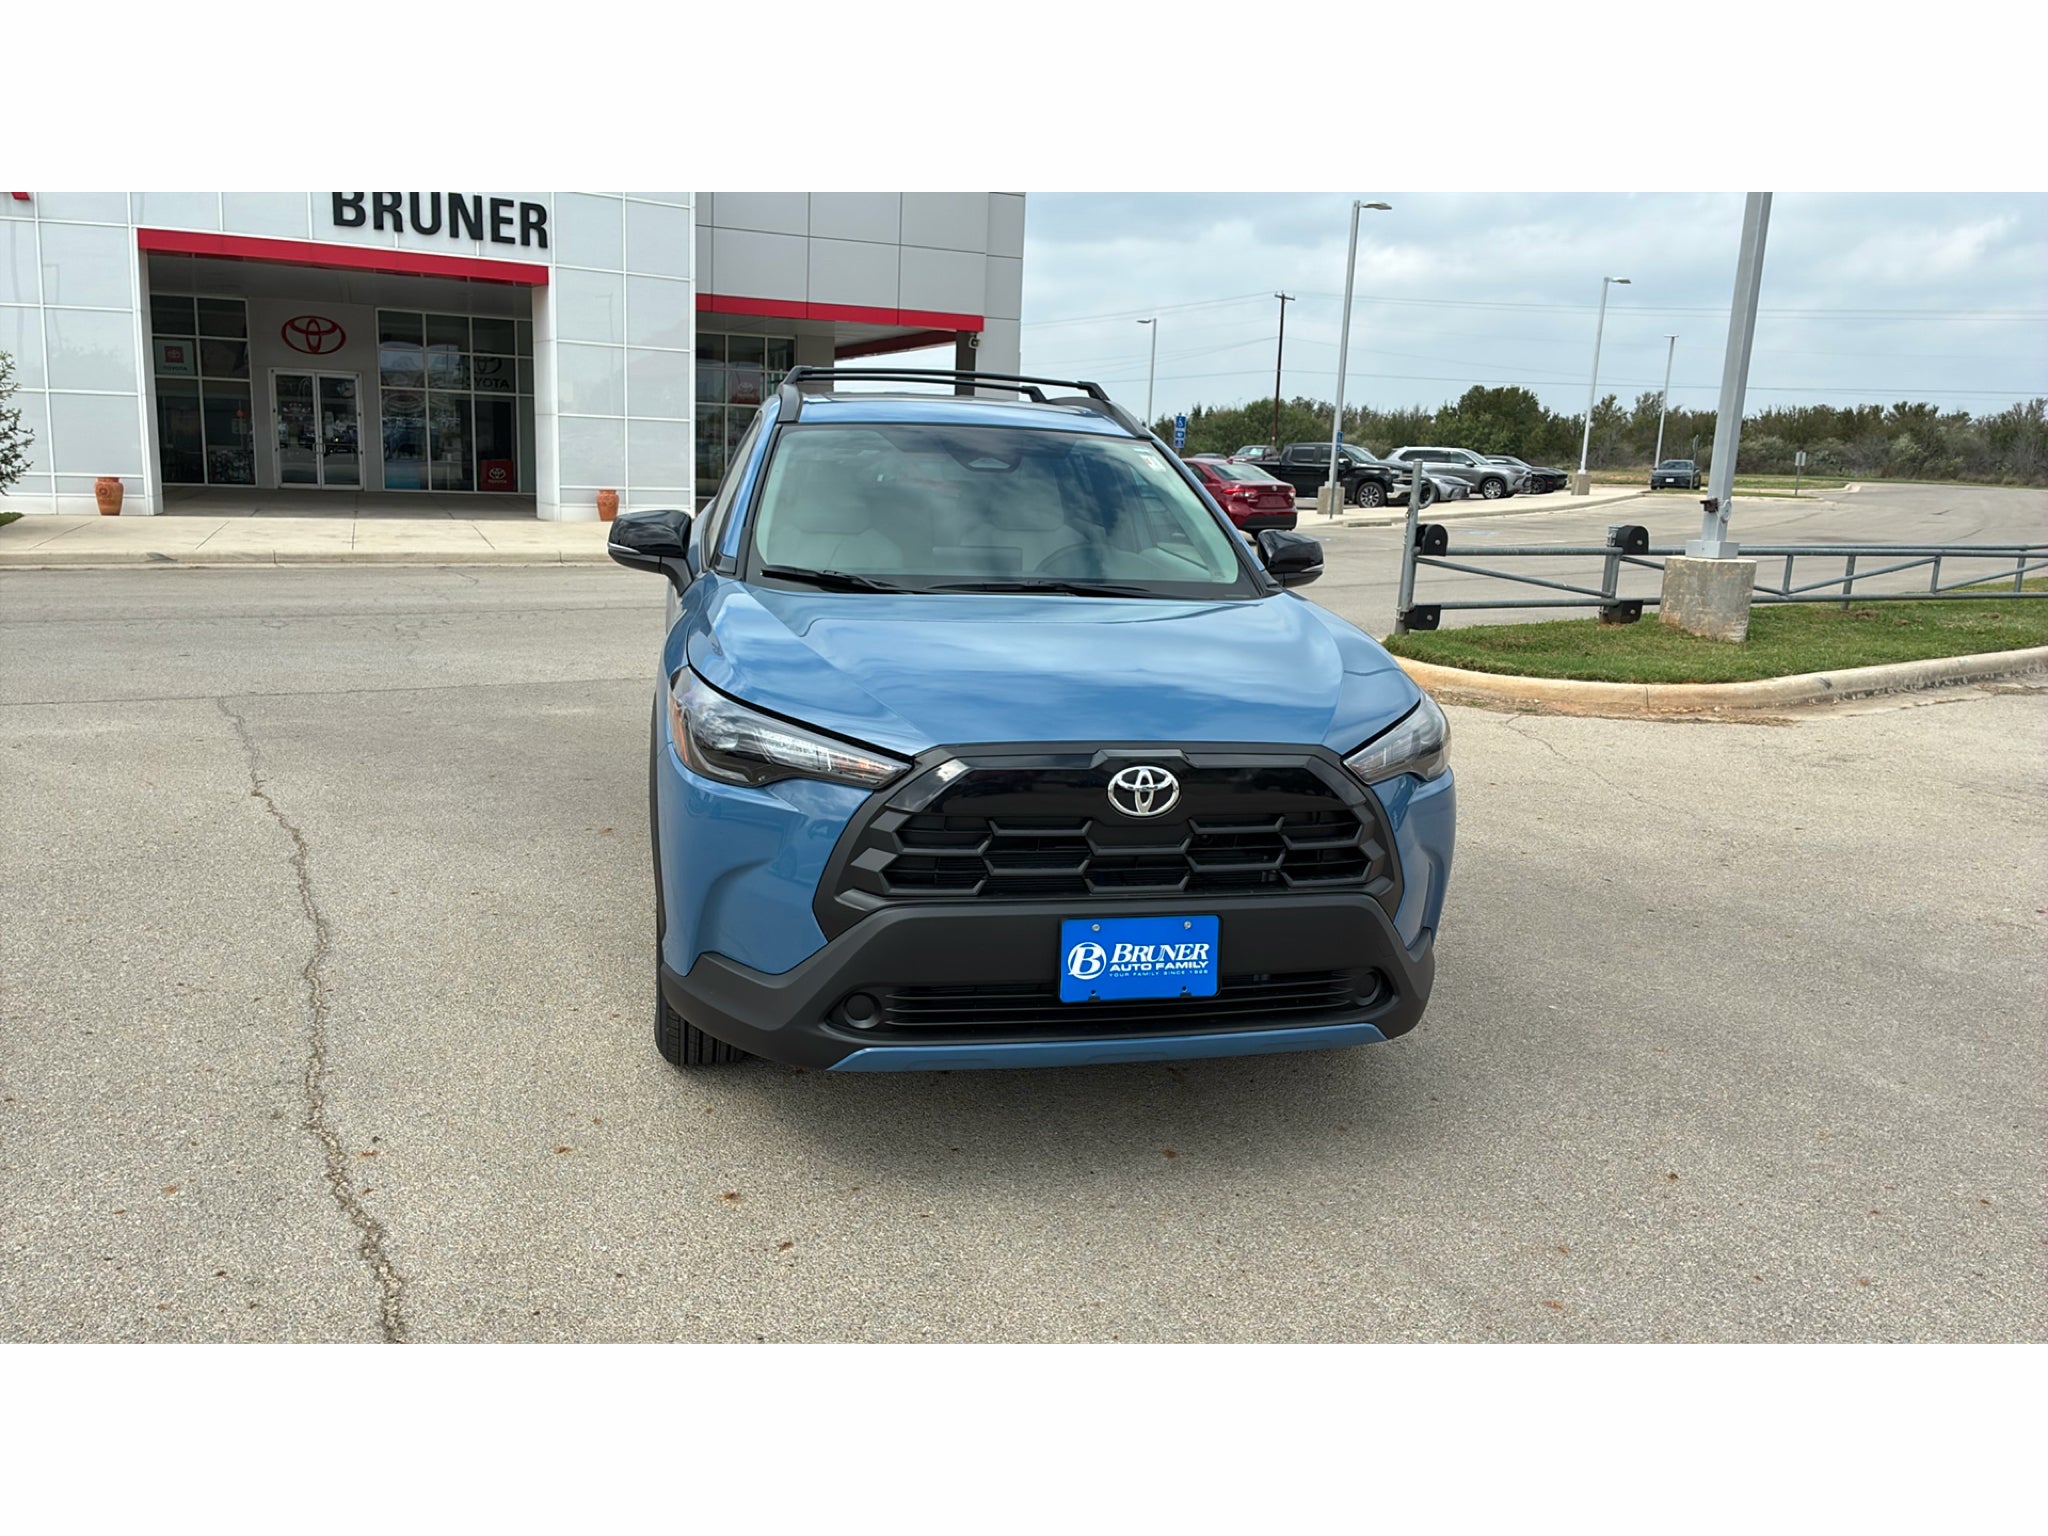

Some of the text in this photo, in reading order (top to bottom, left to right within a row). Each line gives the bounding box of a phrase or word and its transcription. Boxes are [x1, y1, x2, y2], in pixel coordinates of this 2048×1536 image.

[332, 192, 548, 249] BRUNER
[1110, 943, 1210, 964] BRUNER
[1109, 960, 1209, 972] AUTO FAMILY
